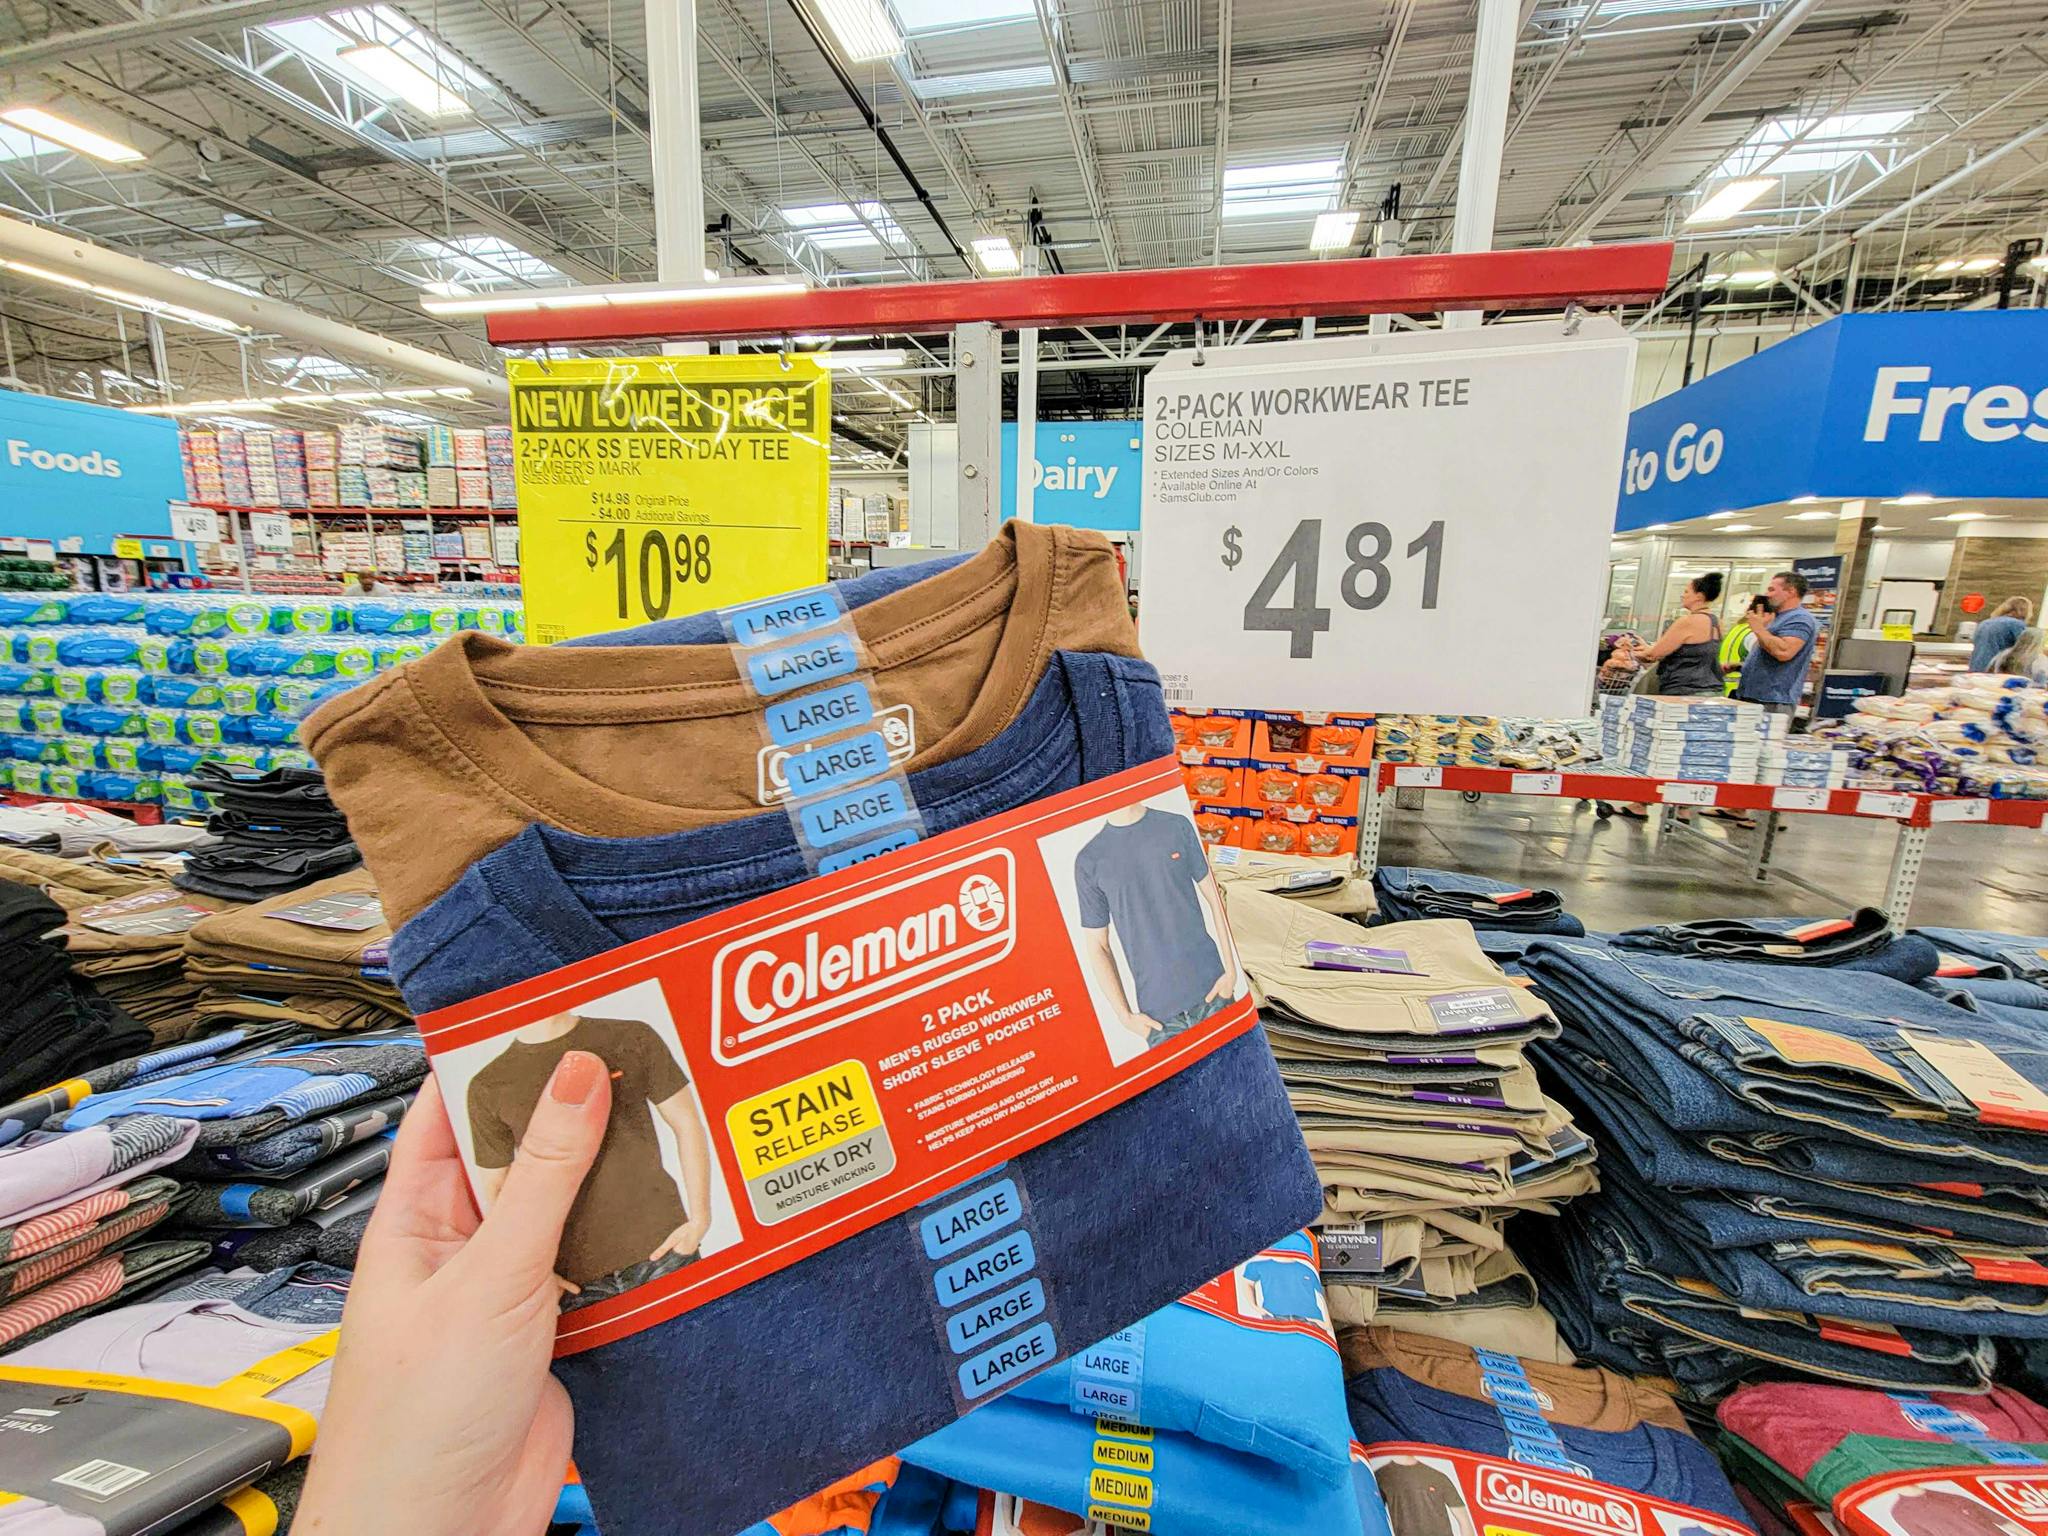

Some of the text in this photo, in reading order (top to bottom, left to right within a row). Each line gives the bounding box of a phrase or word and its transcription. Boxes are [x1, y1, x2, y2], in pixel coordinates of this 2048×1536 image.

[518, 388, 808, 428] NEW LOWER PRICE
[1155, 378, 1471, 421] 2-PACK WORKWEAR TEE
[521, 437, 790, 460] 2-PACK SS EVERYDAY TEE
[1156, 419, 1263, 441] COLEMAN
[7, 439, 123, 479] Foods
[521, 460, 642, 476] MEMBER'S MARK
[1154, 441, 1291, 463] SIZES M-XXL
[1625, 423, 1724, 495] to Go
[1160, 465, 1319, 480] Extended Sizes And/Or Colors
[1160, 479, 1257, 492] Available Online At
[591, 492, 690, 508] $14.98 Original Price
[599, 507, 631, 520] $4.00
[636, 509, 675, 522] Additional
[677, 511, 711, 524] Savings
[1160, 491, 1237, 503] SamsClub.com
[747, 602, 827, 635] LARGE
[763, 645, 844, 682] LARGE
[781, 695, 861, 733] LARGE
[798, 744, 877, 784] LARGE
[816, 794, 895, 834] LARGE
[734, 903, 957, 1024] Coleman
[878, 987, 1054, 1072] MEN'S RUGGED WORKWEAR
[921, 988, 995, 1032] 2 PACK
[882, 1003, 1062, 1091] SHORT SLEEVE POCKET TEE
[913, 1050, 1036, 1111] FABRIC TECHNOLOGY RELEASES
[917, 1065, 1026, 1121] STAINS DURING LAUNDERING
[749, 1075, 854, 1138] STAIN
[924, 1075, 1055, 1143] MOISTURE WICKING AND QUICK DRY
[928, 1074, 1079, 1152] HELPS KEEP YOU DRY AND COMFORTABLE
[754, 1107, 865, 1166] RELEASE
[764, 1137, 873, 1197] QUICK DRY
[776, 1161, 877, 1211] MOISTURE WICKING
[935, 1193, 1010, 1245] LARGE
[948, 1244, 1023, 1294] LARGE
[960, 1291, 1033, 1340] LARGE
[972, 1336, 1045, 1386] LARGE
[1085, 1354, 1130, 1375] LARGE
[1485, 1359, 1518, 1374] LARGE
[1083, 1387, 1128, 1407] LARGE
[1490, 1375, 1527, 1390] LARGE
[1099, 1420, 1150, 1437] MEDIUM
[1511, 1421, 1551, 1438] LARGE
[1097, 1446, 1150, 1466] MEDIUM
[1518, 1440, 1561, 1460] LARGE
[1095, 1476, 1149, 1501] MEDIUM
[1487, 1472, 1608, 1524] Coleman
[1092, 1509, 1146, 1528] MEDIUM
